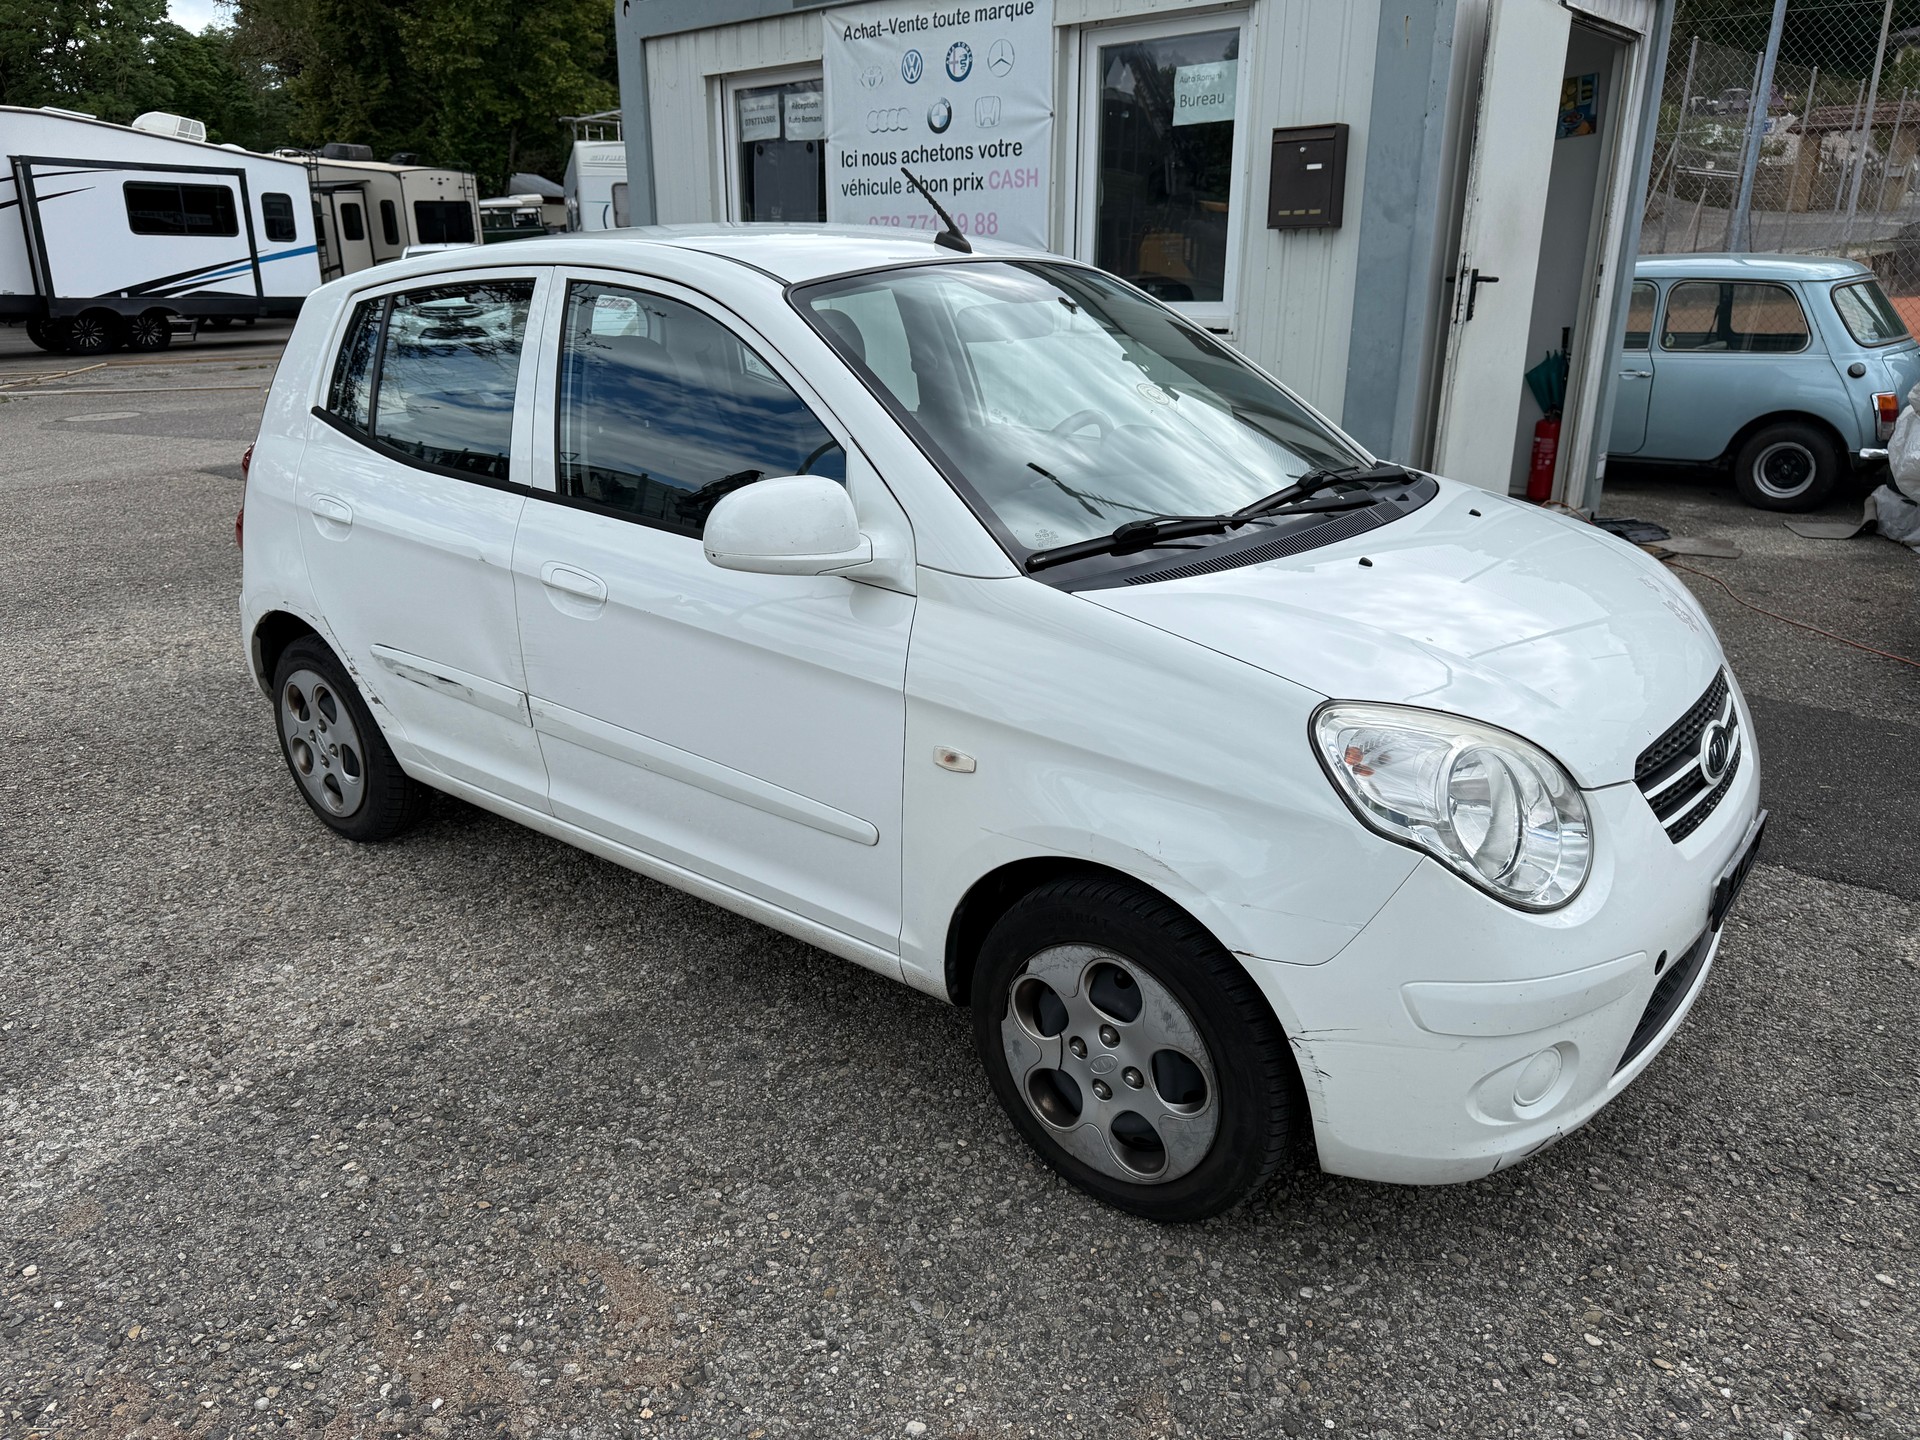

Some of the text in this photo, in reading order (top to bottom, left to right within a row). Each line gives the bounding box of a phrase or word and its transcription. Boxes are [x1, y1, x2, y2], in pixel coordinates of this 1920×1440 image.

[843, 1, 1035, 42] Achat-Vente toute marque
[791, 102, 819, 111] Réception
[1180, 93, 1225, 108] Bureau
[841, 139, 1023, 168] Ici nous achetons votre
[841, 177, 902, 197] véhicule
[919, 175, 948, 193] bon
[953, 172, 984, 196] prix
[988, 168, 1039, 190] CASH
[975, 212, 998, 235] 88
